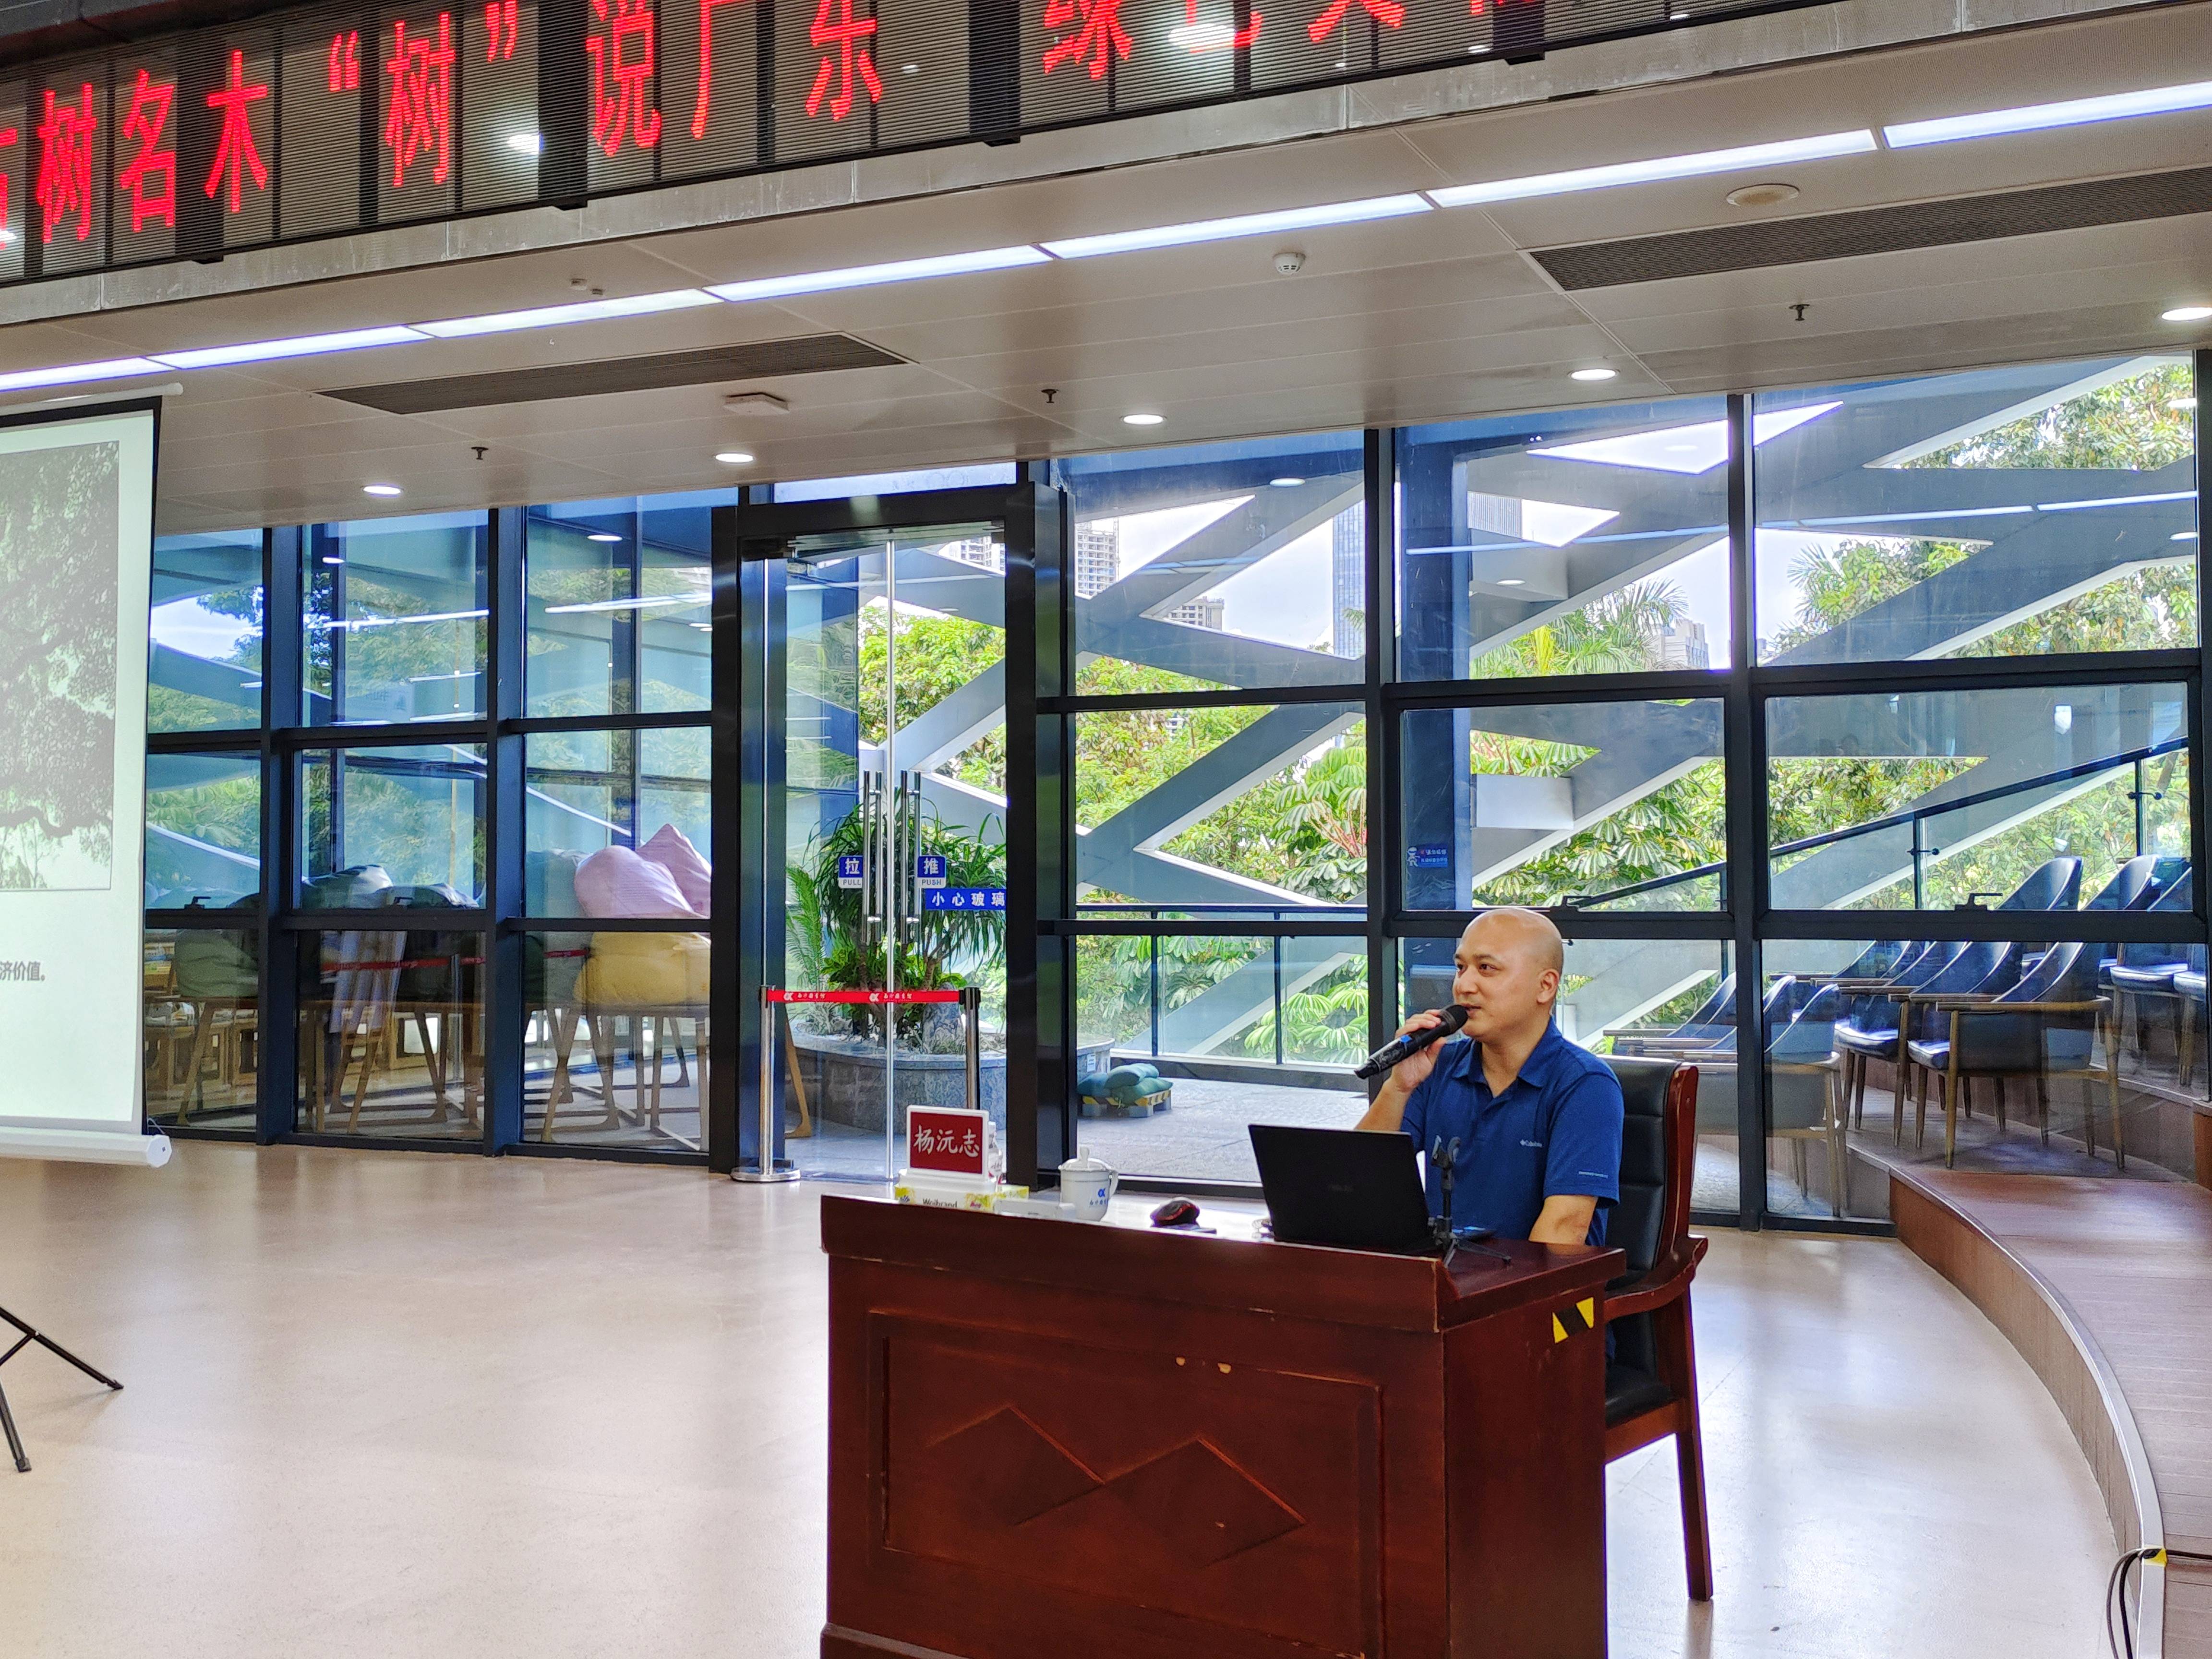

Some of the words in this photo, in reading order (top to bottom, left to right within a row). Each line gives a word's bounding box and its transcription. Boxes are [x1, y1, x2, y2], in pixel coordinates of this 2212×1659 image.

[845, 857, 860, 875] 拉
[924, 857, 939, 875] 推
[932, 891, 1005, 907] 小心玻璃
[913, 1124, 980, 1158] 杨沅志
